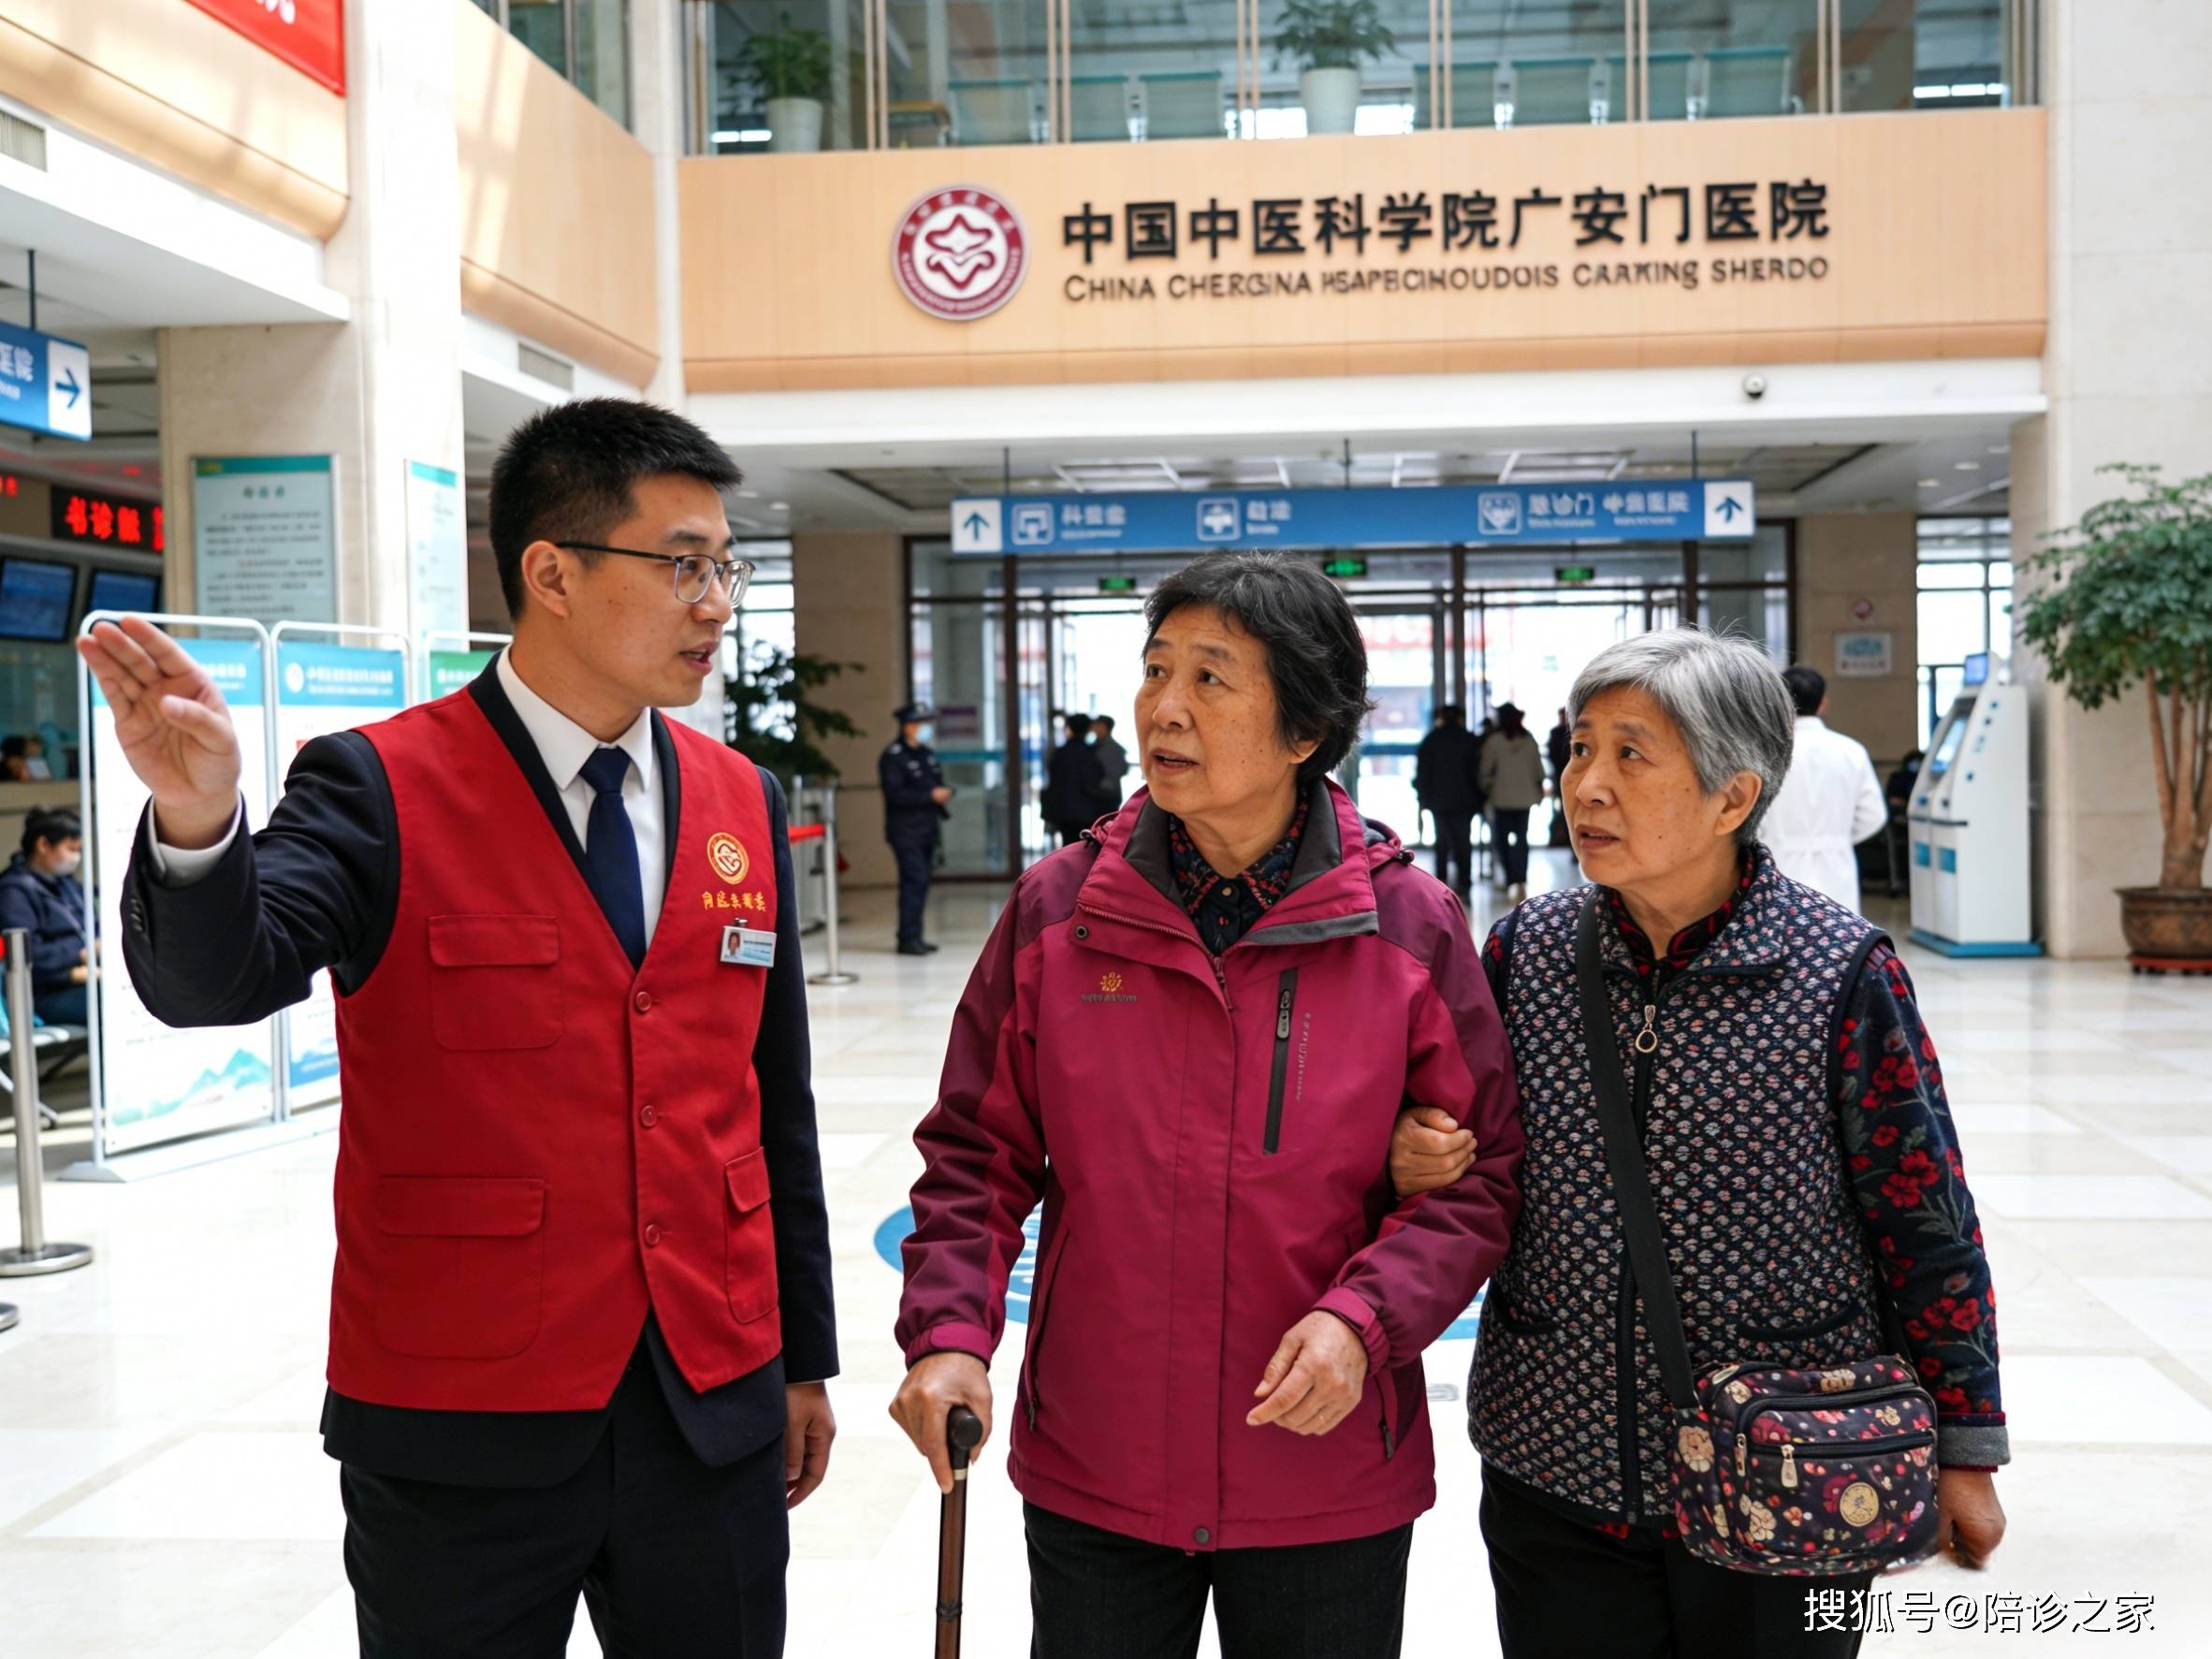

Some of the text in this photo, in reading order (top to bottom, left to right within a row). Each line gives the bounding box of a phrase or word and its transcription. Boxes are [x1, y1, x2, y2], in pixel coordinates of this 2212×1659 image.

[1063, 178, 1830, 265] 中国中医科学院广安门医院
[1064, 274, 1156, 302] CHINA
[1711, 256, 1829, 283] SHERDO
